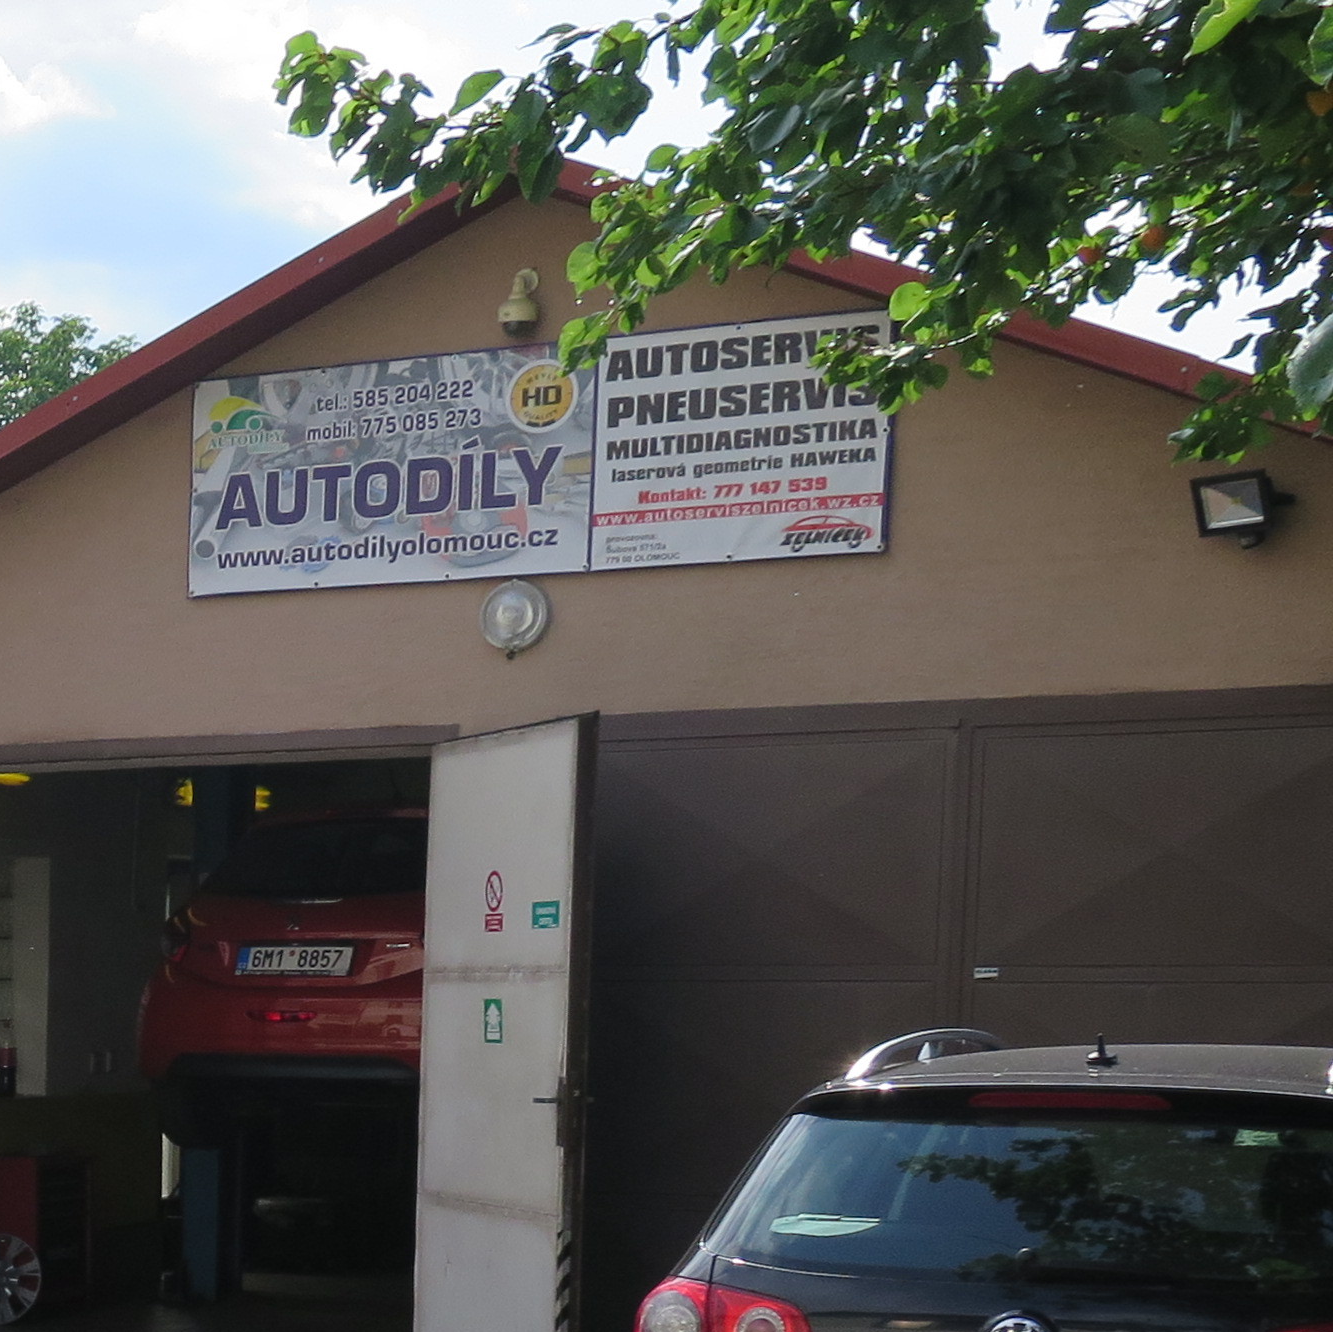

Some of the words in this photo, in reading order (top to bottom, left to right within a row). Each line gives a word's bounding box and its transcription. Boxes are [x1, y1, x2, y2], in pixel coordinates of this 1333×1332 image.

[606, 324, 880, 382] AUTOSERVS
[316, 395, 348, 412] tel.:
[352, 388, 389, 409] 585
[395, 384, 431, 405] 204
[437, 379, 474, 401] 222
[522, 385, 562, 407] HD
[306, 421, 356, 442] mobil:
[361, 415, 397, 437] 775
[403, 411, 439, 433] 085
[445, 408, 482, 429] 273
[606, 418, 877, 461] MULTIDIAGNOSTIKA
[611, 462, 686, 482] laserová
[693, 454, 783, 479] geometrie
[790, 447, 876, 468] HAWEKA
[215, 436, 564, 531] AUTODÍLY
[713, 483, 744, 498] 777
[750, 480, 781, 495] 147
[788, 477, 828, 492] 539
[217, 528, 559, 569] www.autodilyolomouc.cz
[252, 950, 283, 968] 6M1
[297, 949, 344, 968] 8857
